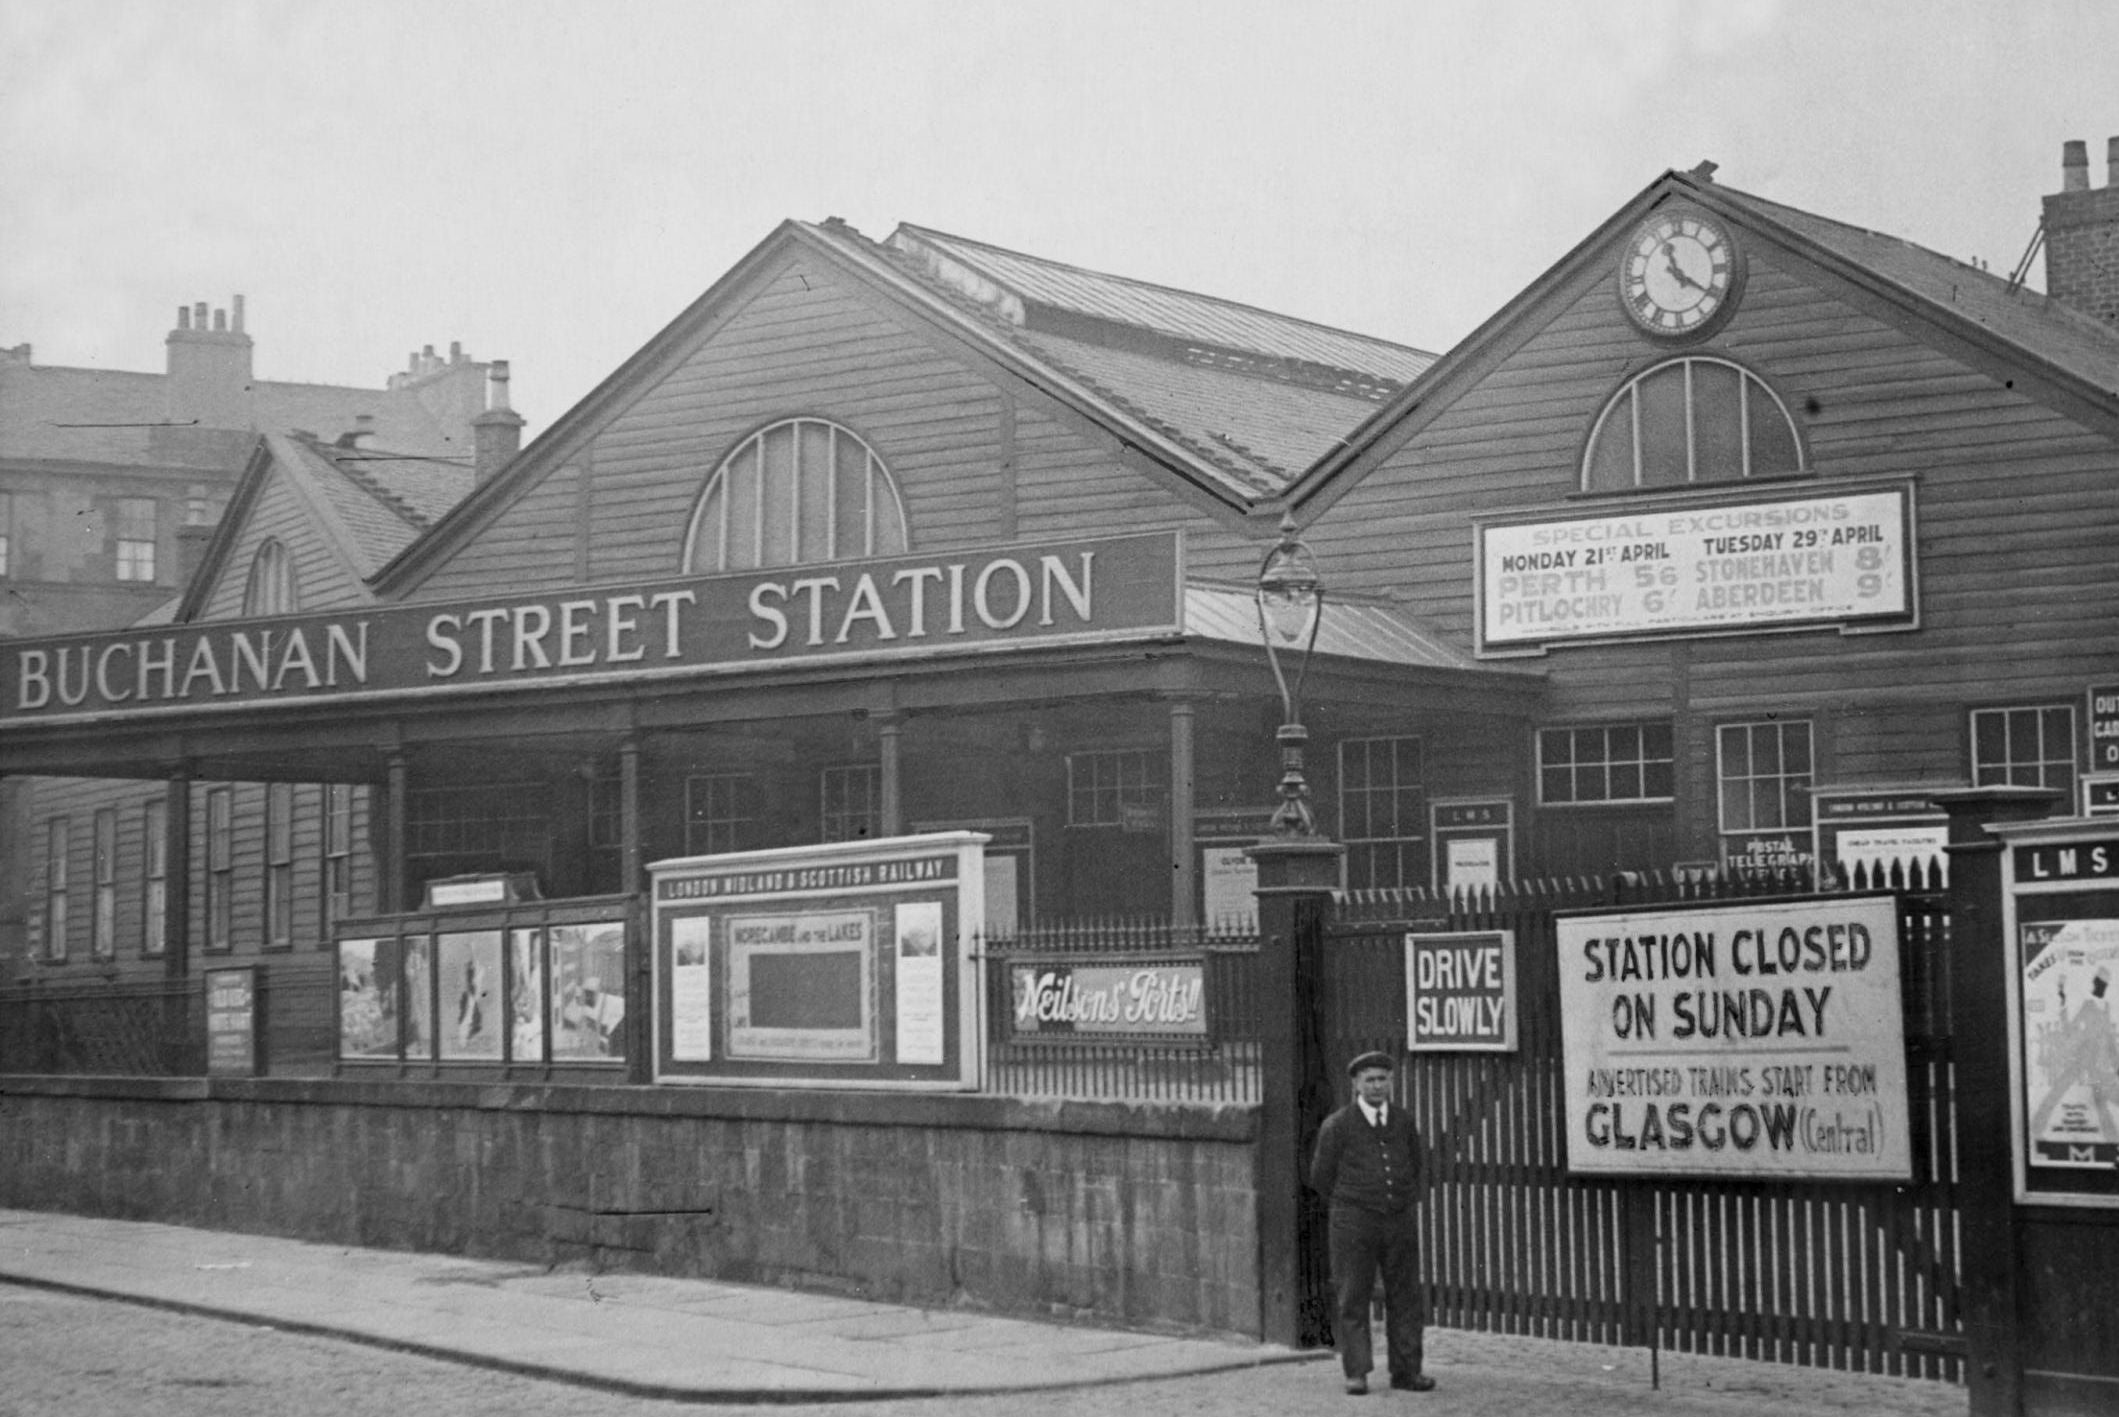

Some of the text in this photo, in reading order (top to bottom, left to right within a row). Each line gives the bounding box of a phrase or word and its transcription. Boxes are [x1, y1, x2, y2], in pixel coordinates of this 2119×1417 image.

[1532, 503, 1849, 546] SPECIAL EXCURSIONS
[1703, 532, 1784, 555] TUESDAY
[1831, 524, 1884, 546] APRIL
[1502, 549, 1577, 573] MONDAY
[1621, 542, 1671, 562] APRIL
[1695, 550, 1835, 583] STONEHAVEN
[1500, 568, 1607, 598] PERTH
[1696, 578, 1825, 612] ABERDEEN
[1500, 593, 1623, 626] PITLOCHRY
[18, 552, 1095, 709] BUCHANAN STREET STATION
[667, 878, 718, 898] LONDON
[724, 872, 783, 894] MIDLAND
[800, 865, 872, 888] SCOTTISH
[878, 859, 943, 882] RAILWAY
[1418, 948, 1501, 989] DRIVE
[1584, 922, 1871, 983] STATION CLOSED
[1417, 996, 1504, 1035] SLOWLY
[1612, 986, 1832, 1040] ON SUNDAY
[1586, 1063, 1878, 1098] ADVERTISED TRAINS START FROM
[1584, 1102, 1798, 1151] GLASGOW
